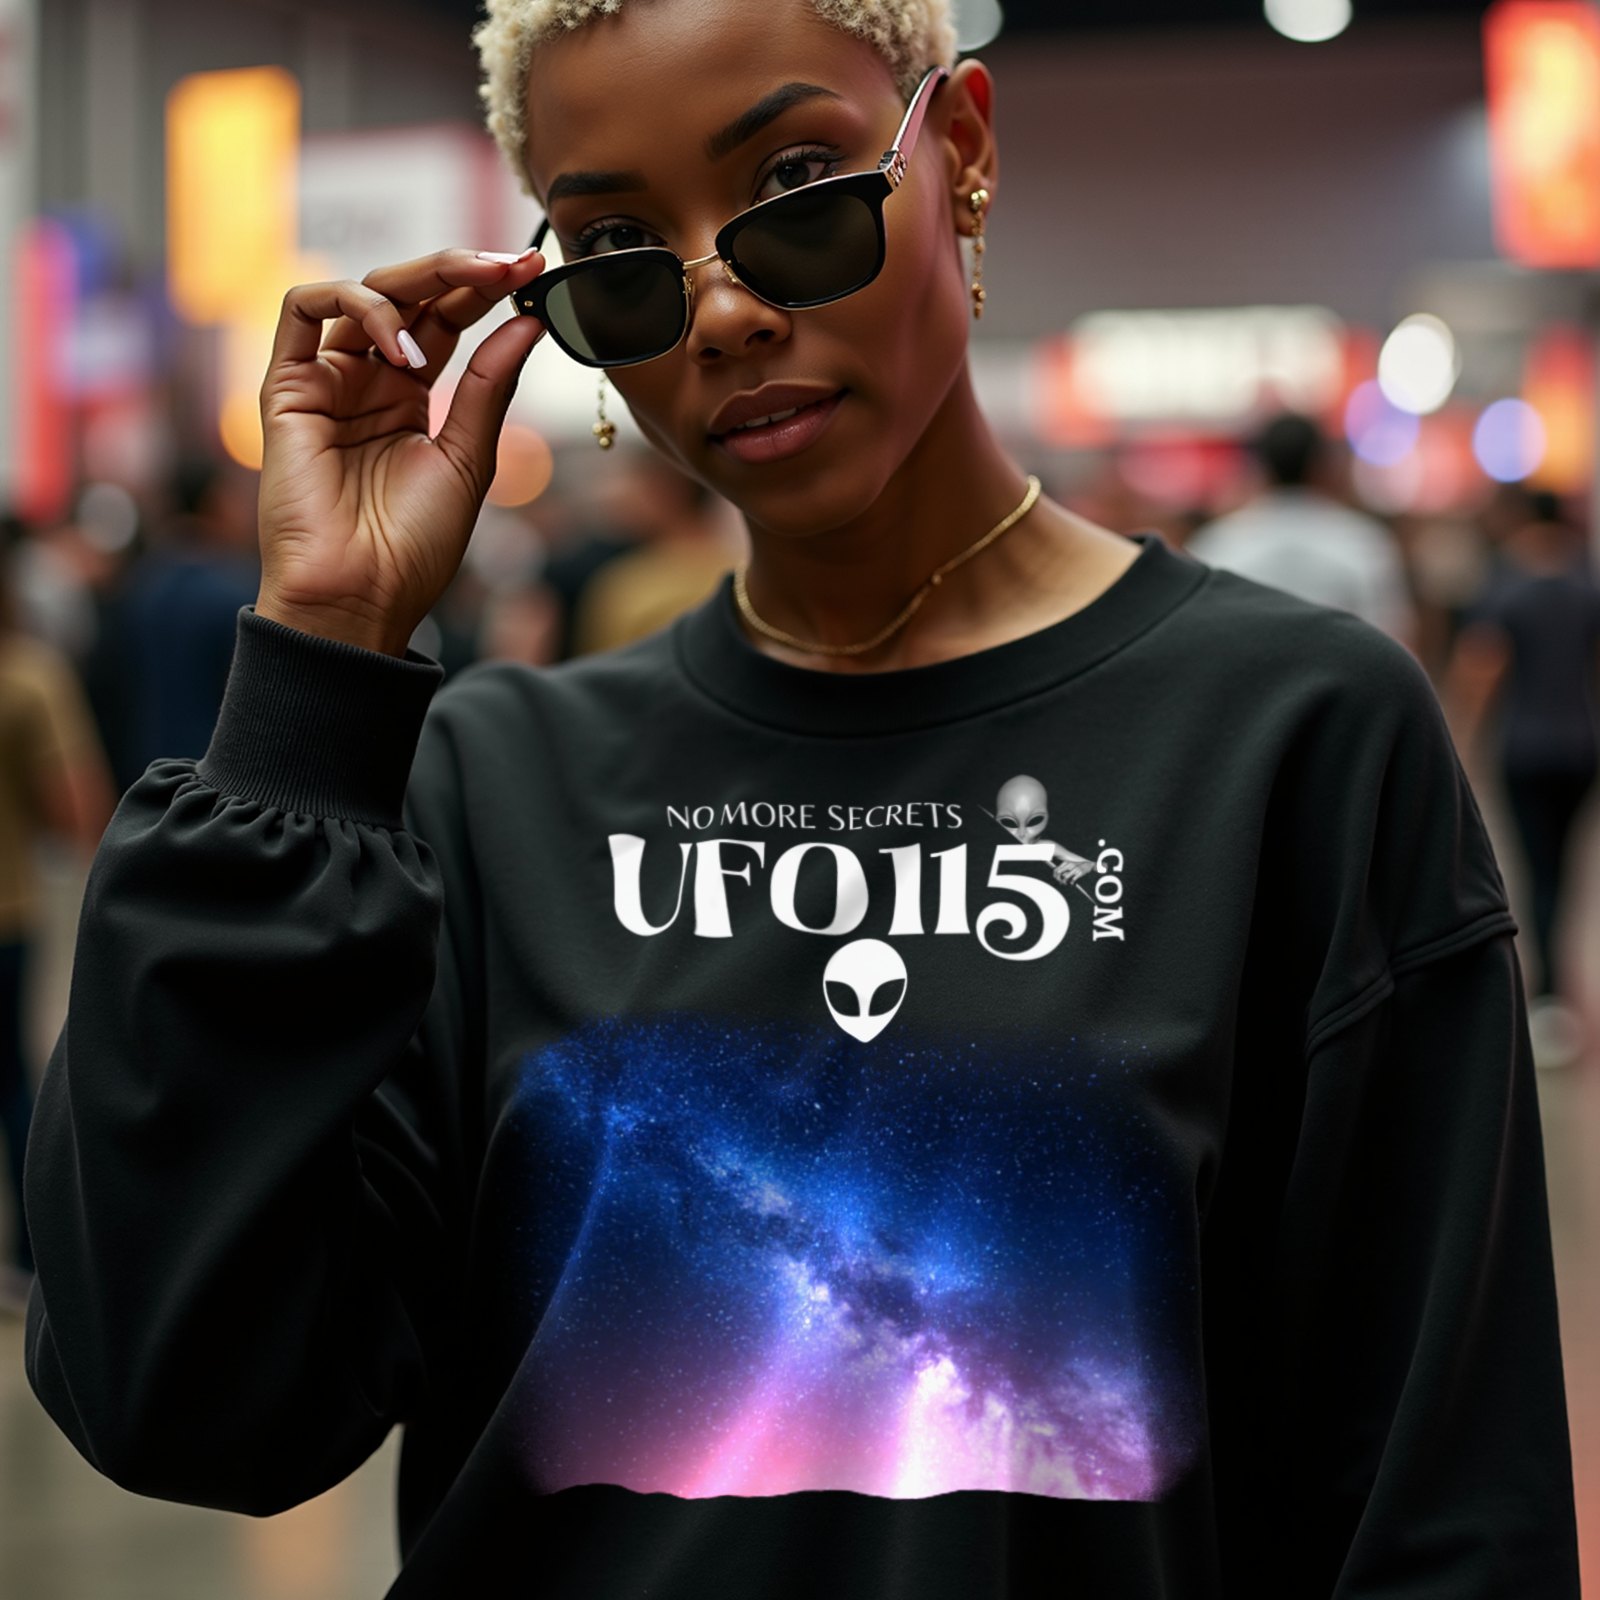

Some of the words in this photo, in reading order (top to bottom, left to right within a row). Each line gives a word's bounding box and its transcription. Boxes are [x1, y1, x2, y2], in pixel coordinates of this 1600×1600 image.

[666, 804, 715, 830] NO
[719, 801, 816, 829] MORE
[827, 802, 963, 831] SECRETS
[608, 833, 1071, 961] UFO115
[1092, 838, 1125, 942] .COM
